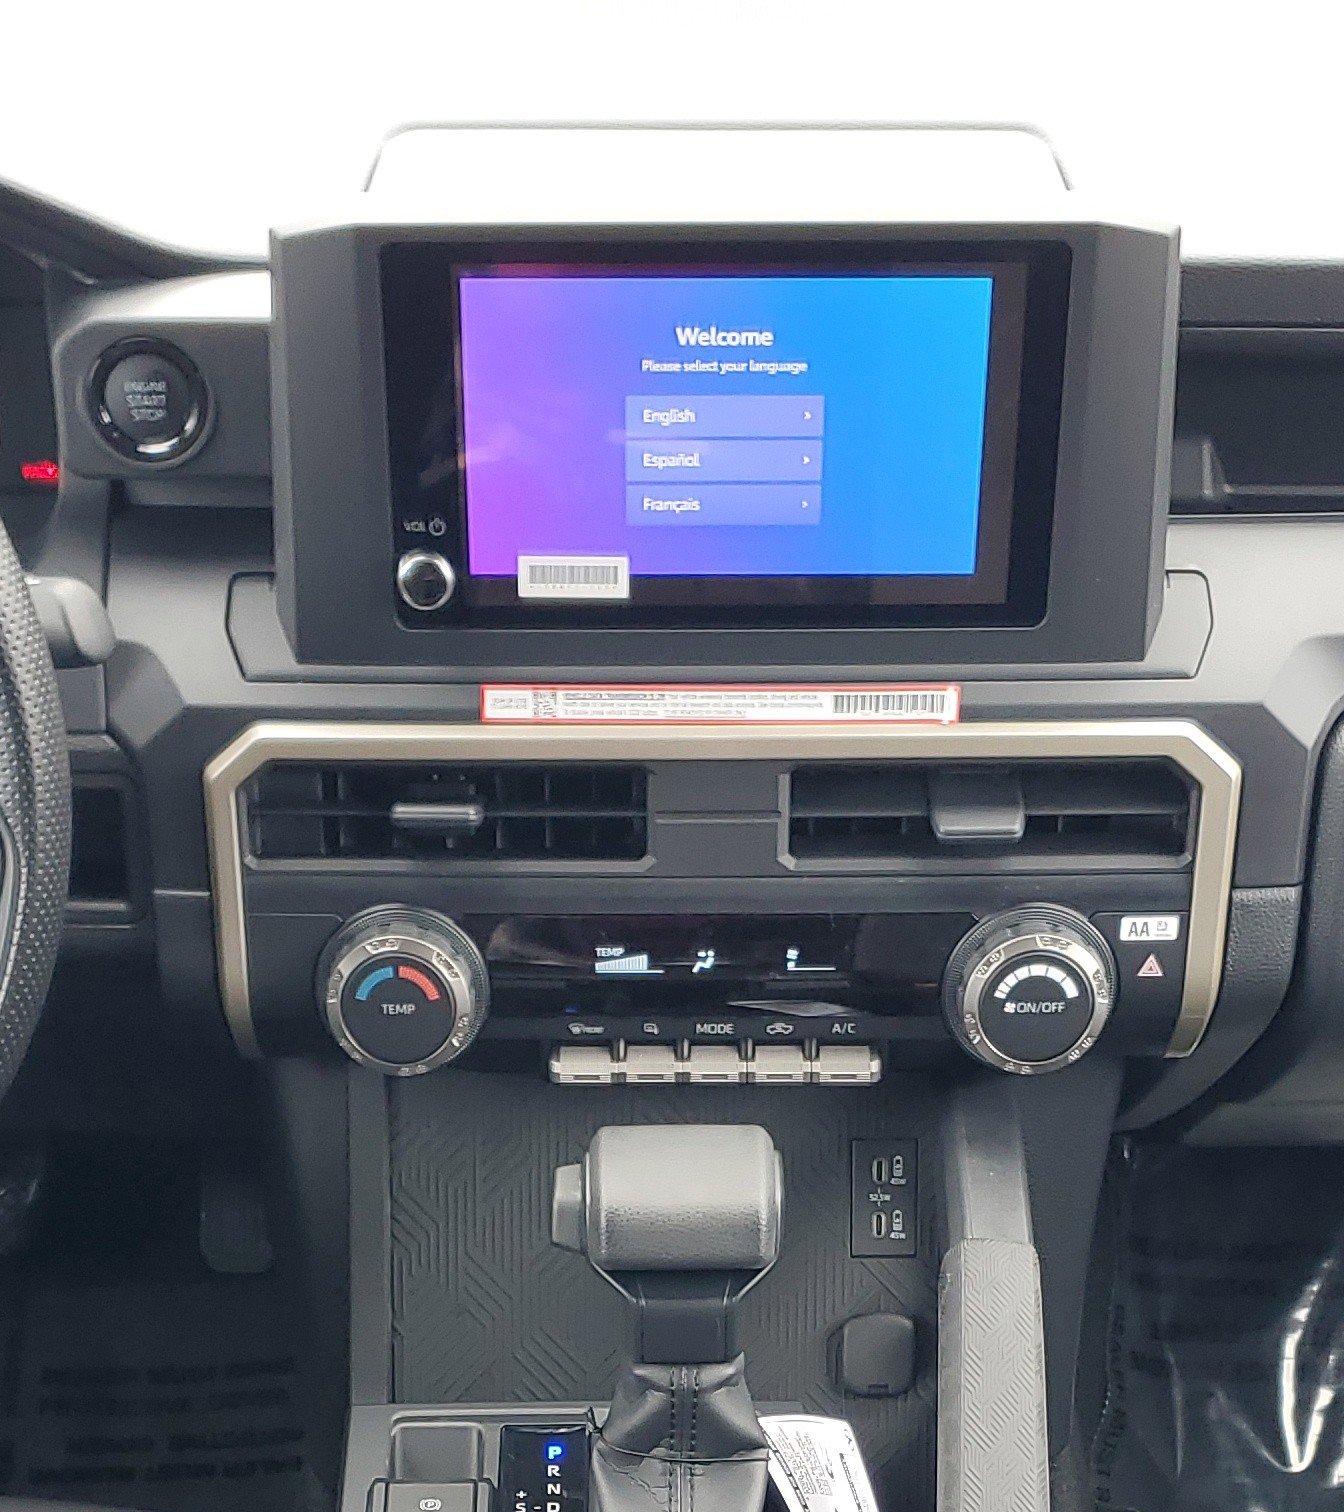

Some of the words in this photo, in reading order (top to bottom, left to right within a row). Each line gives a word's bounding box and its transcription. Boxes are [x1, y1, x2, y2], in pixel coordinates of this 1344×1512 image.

[675, 326, 775, 347] Welcome
[641, 359, 681, 373] Please
[683, 359, 719, 373] select
[719, 361, 749, 375] your
[749, 359, 809, 375] language
[642, 408, 697, 427] English
[642, 453, 701, 470] Español
[642, 497, 702, 514] Français
[1127, 921, 1150, 937] AA
[594, 947, 625, 957] TEMP
[381, 1003, 416, 1015] TEMP
[1016, 1001, 1066, 1014] ON/OFF
[696, 1023, 735, 1035] MODE
[831, 1023, 856, 1035] A/C
[548, 1445, 563, 1460] P
[547, 1464, 562, 1477] R
[547, 1483, 561, 1495] N
